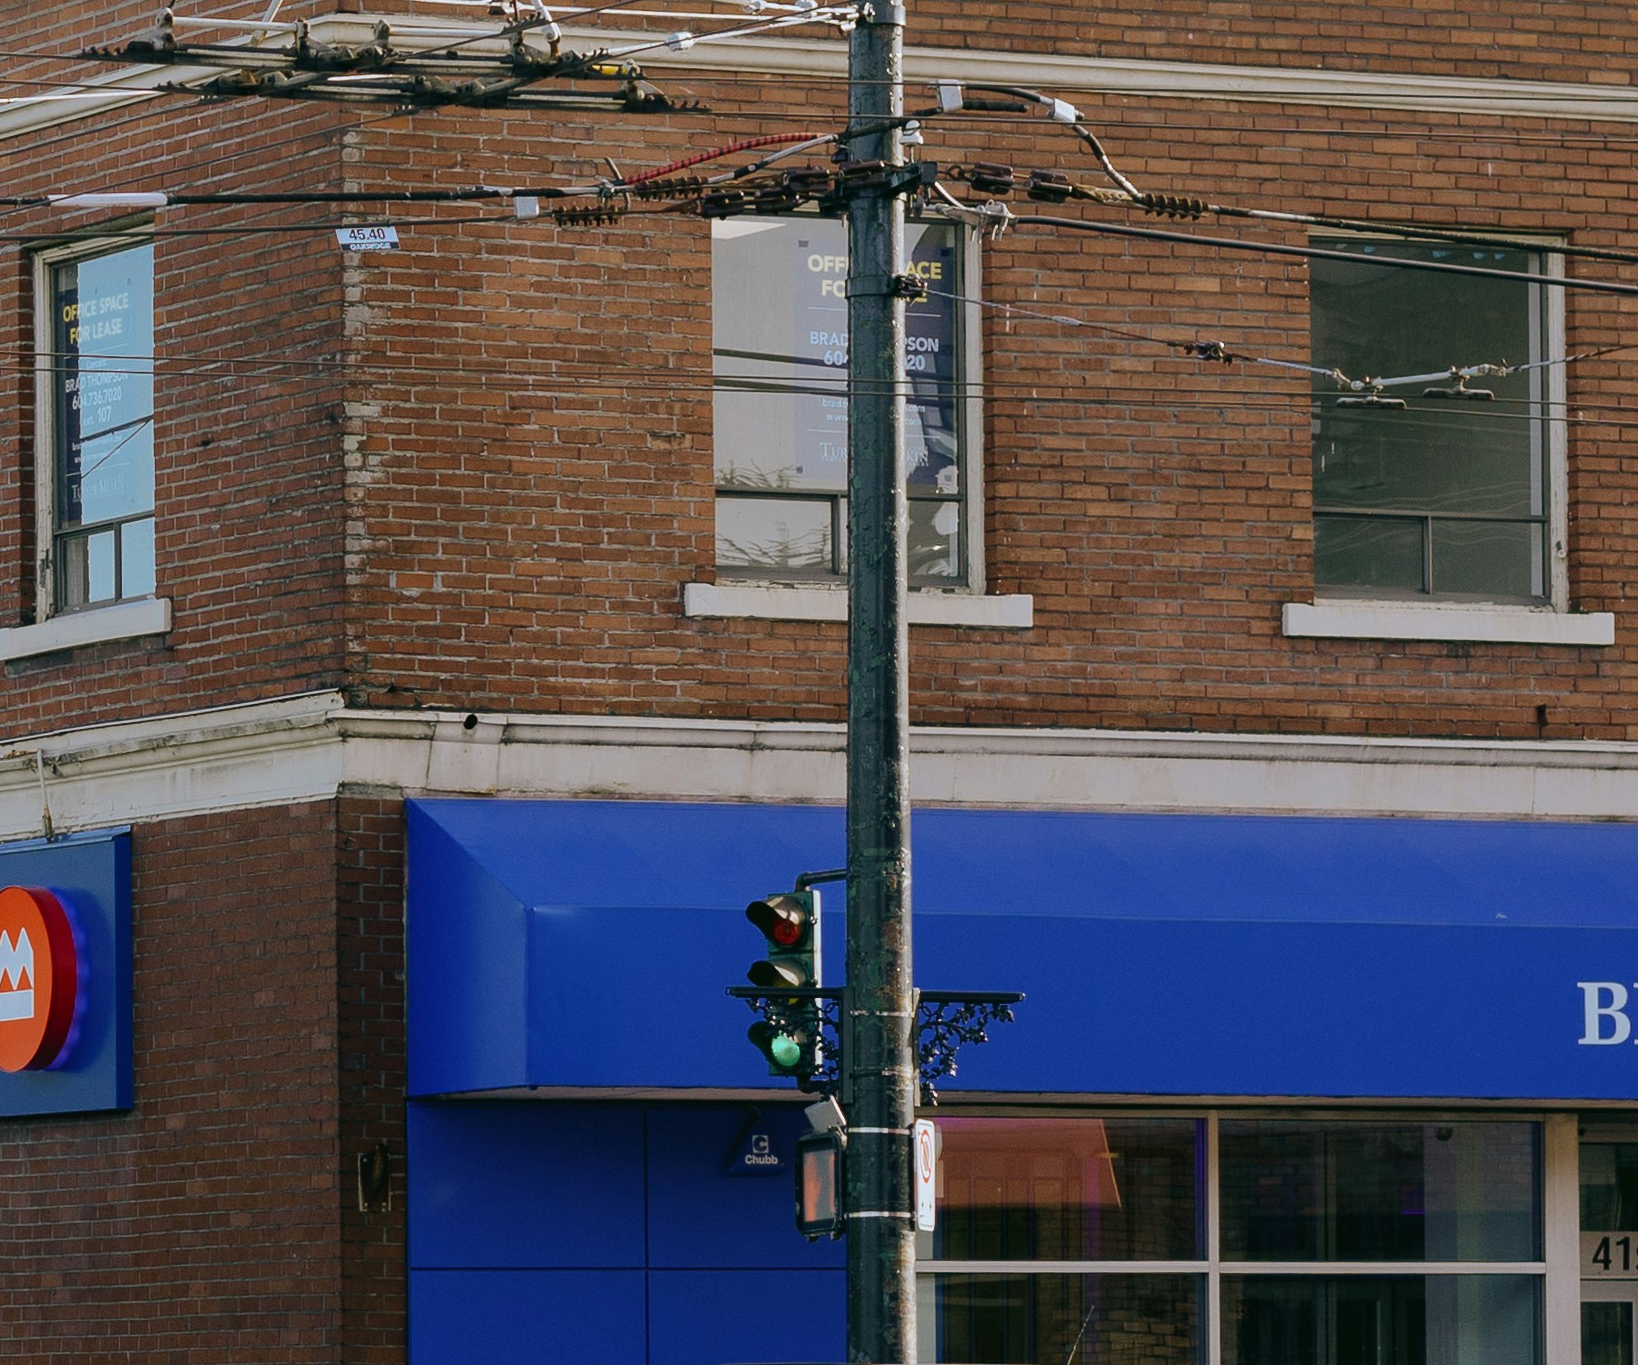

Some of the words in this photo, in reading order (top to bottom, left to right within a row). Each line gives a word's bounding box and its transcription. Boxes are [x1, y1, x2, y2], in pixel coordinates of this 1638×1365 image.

[807, 254, 848, 273] OFFI
[905, 261, 942, 280] ACE
[821, 279, 846, 297] FO
[745, 1154, 778, 1166] Chubb
